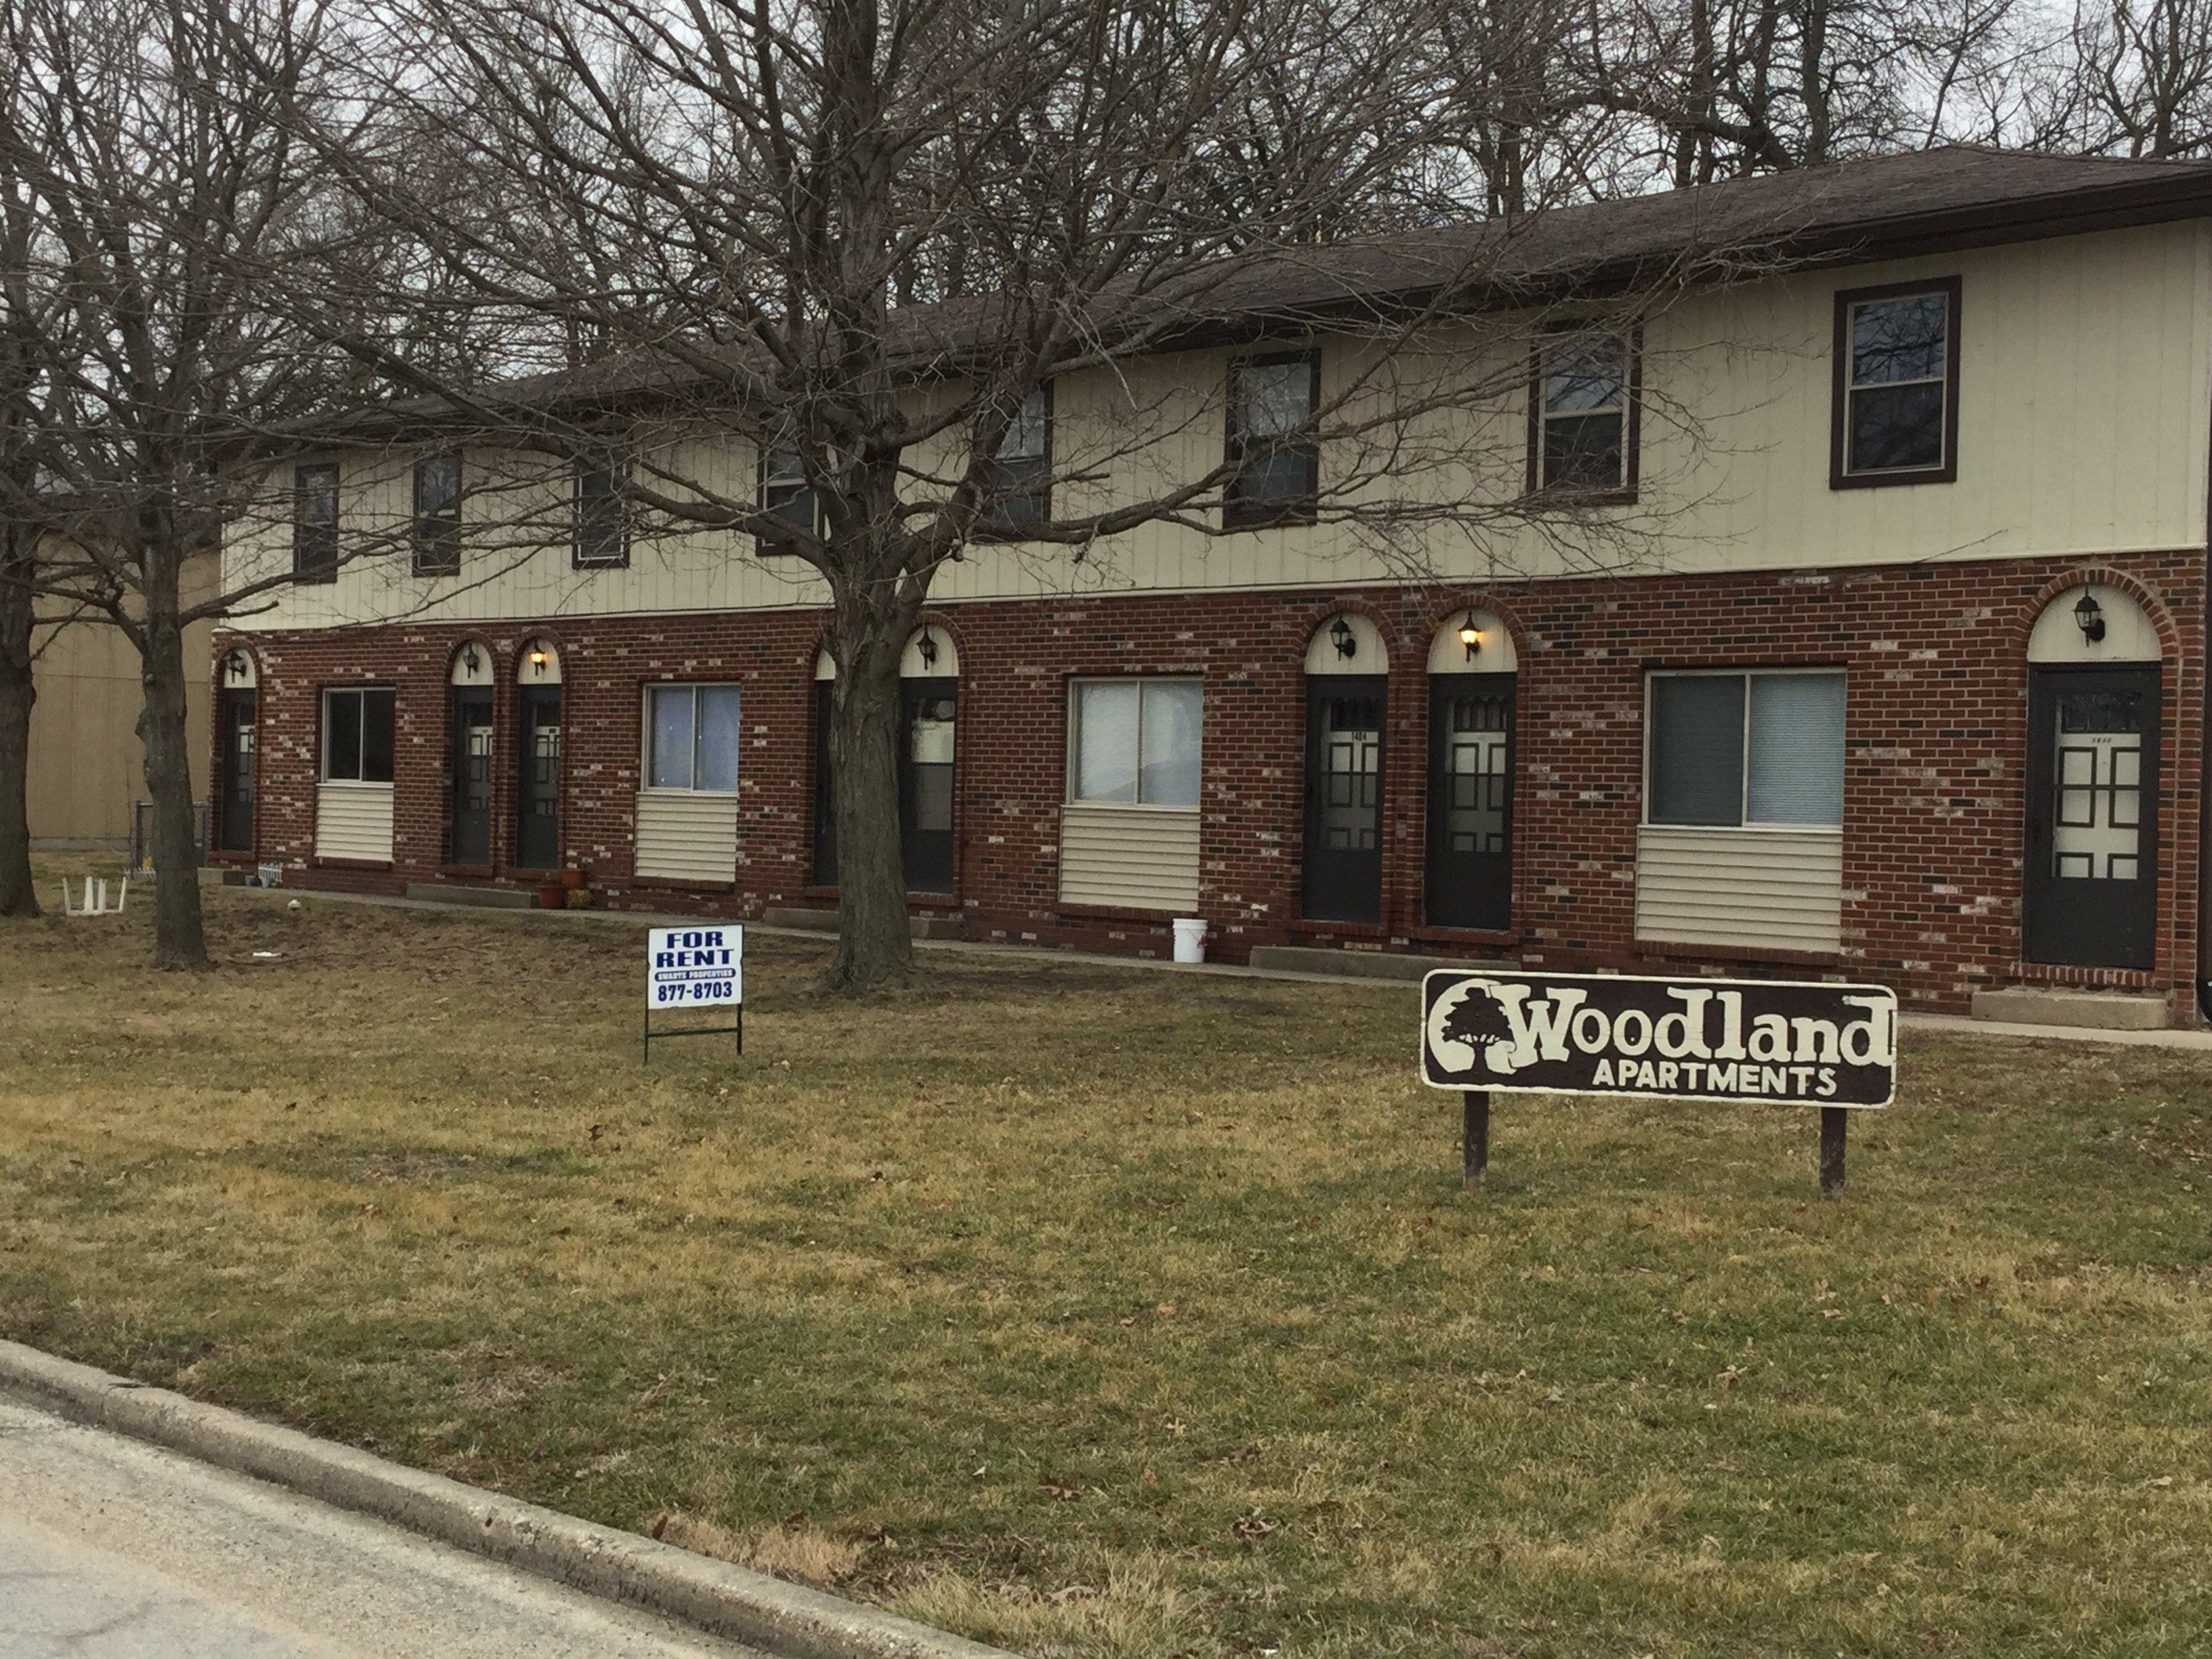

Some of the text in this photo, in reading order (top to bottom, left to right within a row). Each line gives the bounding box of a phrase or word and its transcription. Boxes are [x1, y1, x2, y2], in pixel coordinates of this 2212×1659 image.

[667, 931, 723, 949] FOR
[656, 949, 735, 968] RENT
[689, 969, 733, 979] PROPERTIES
[658, 981, 733, 1002] 877-8703
[1489, 983, 1895, 1067] Woodland
[1592, 1058, 1837, 1096] APARTMENTS
